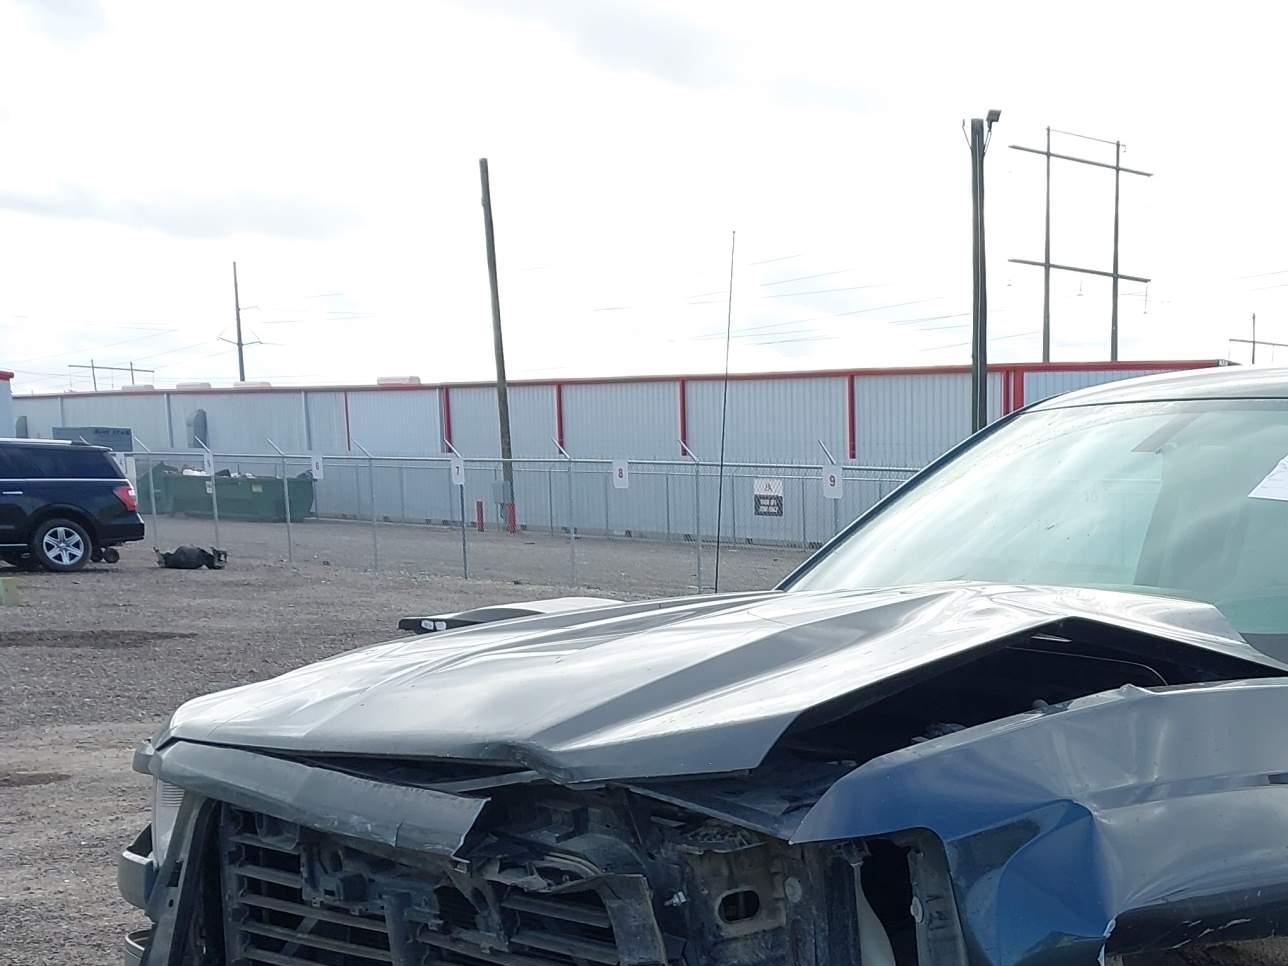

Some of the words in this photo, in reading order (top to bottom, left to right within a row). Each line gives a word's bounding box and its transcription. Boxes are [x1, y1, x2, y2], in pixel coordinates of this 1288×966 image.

[454, 466, 461, 475] 7
[617, 468, 625, 478] 8
[829, 475, 836, 487] 9
